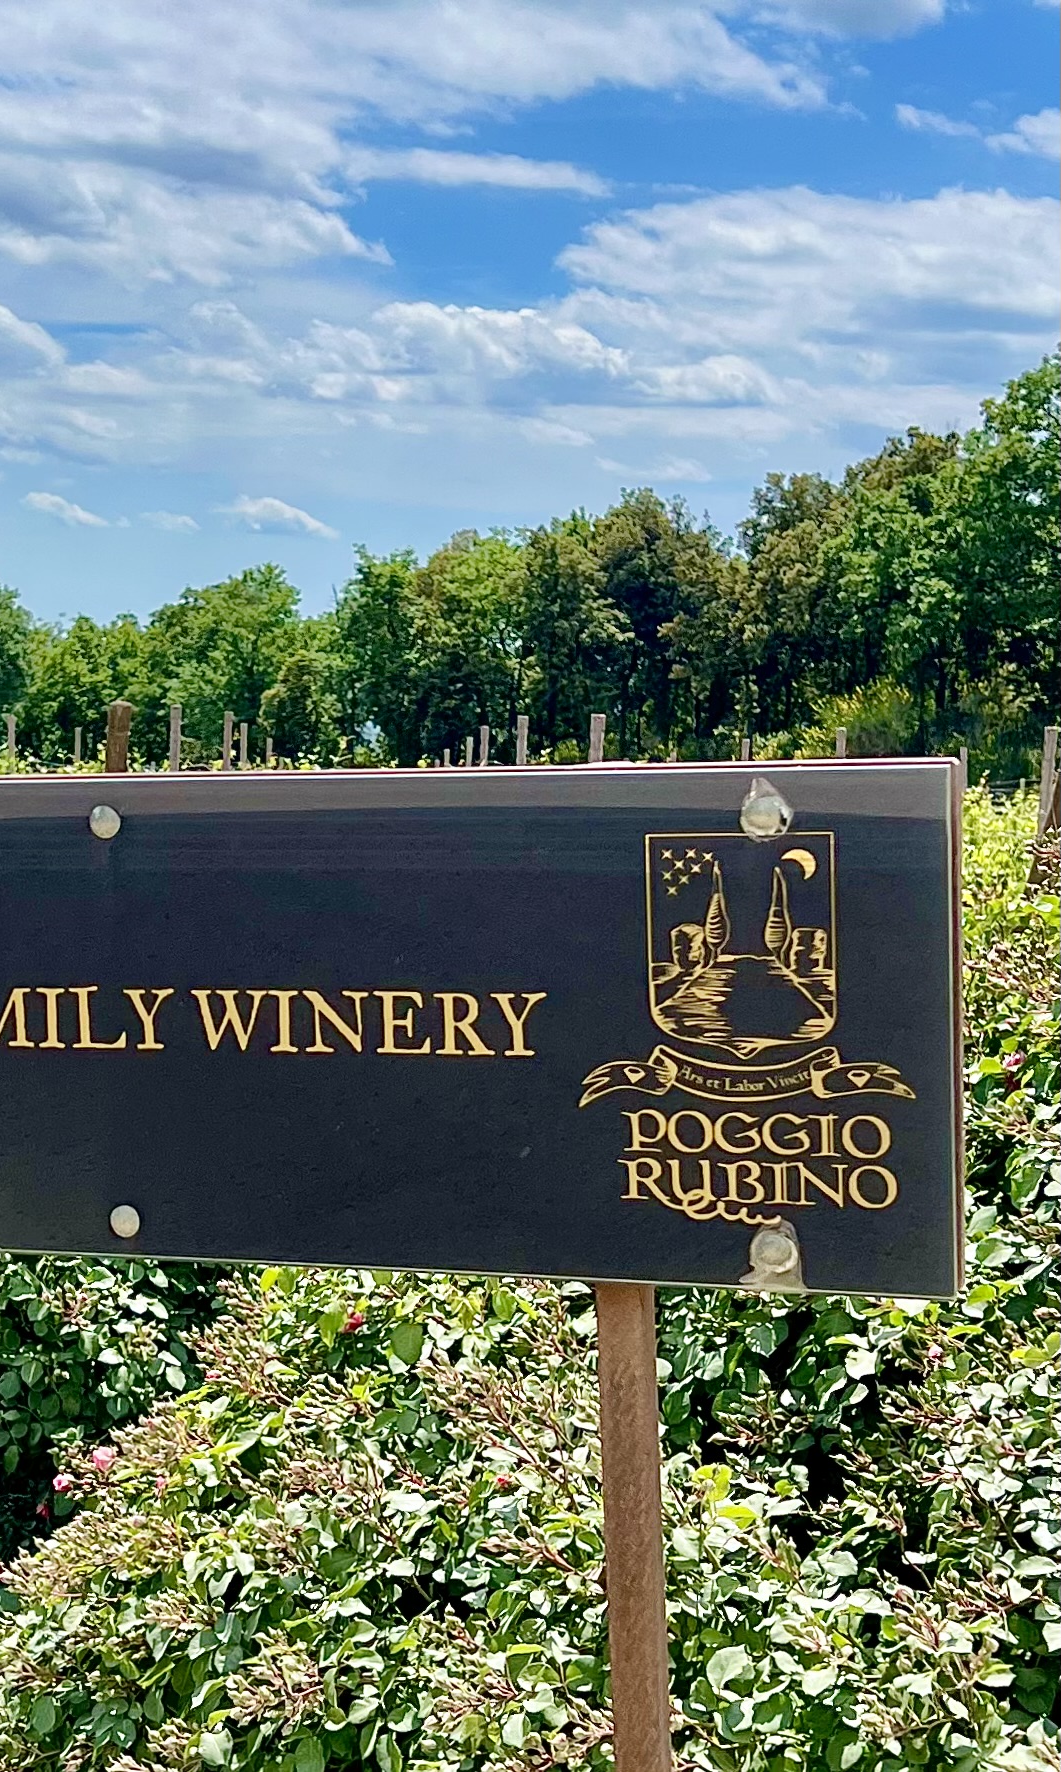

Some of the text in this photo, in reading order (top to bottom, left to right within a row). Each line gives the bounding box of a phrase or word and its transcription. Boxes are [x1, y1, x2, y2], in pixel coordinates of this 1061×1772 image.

[189, 988, 548, 1057] WINERY
[679, 1065, 703, 1084] Ars
[706, 1079, 720, 1089] et
[723, 1077, 765, 1091] Labor
[621, 1109, 891, 1159] POGGIO
[618, 1158, 898, 1225] RUBINO
